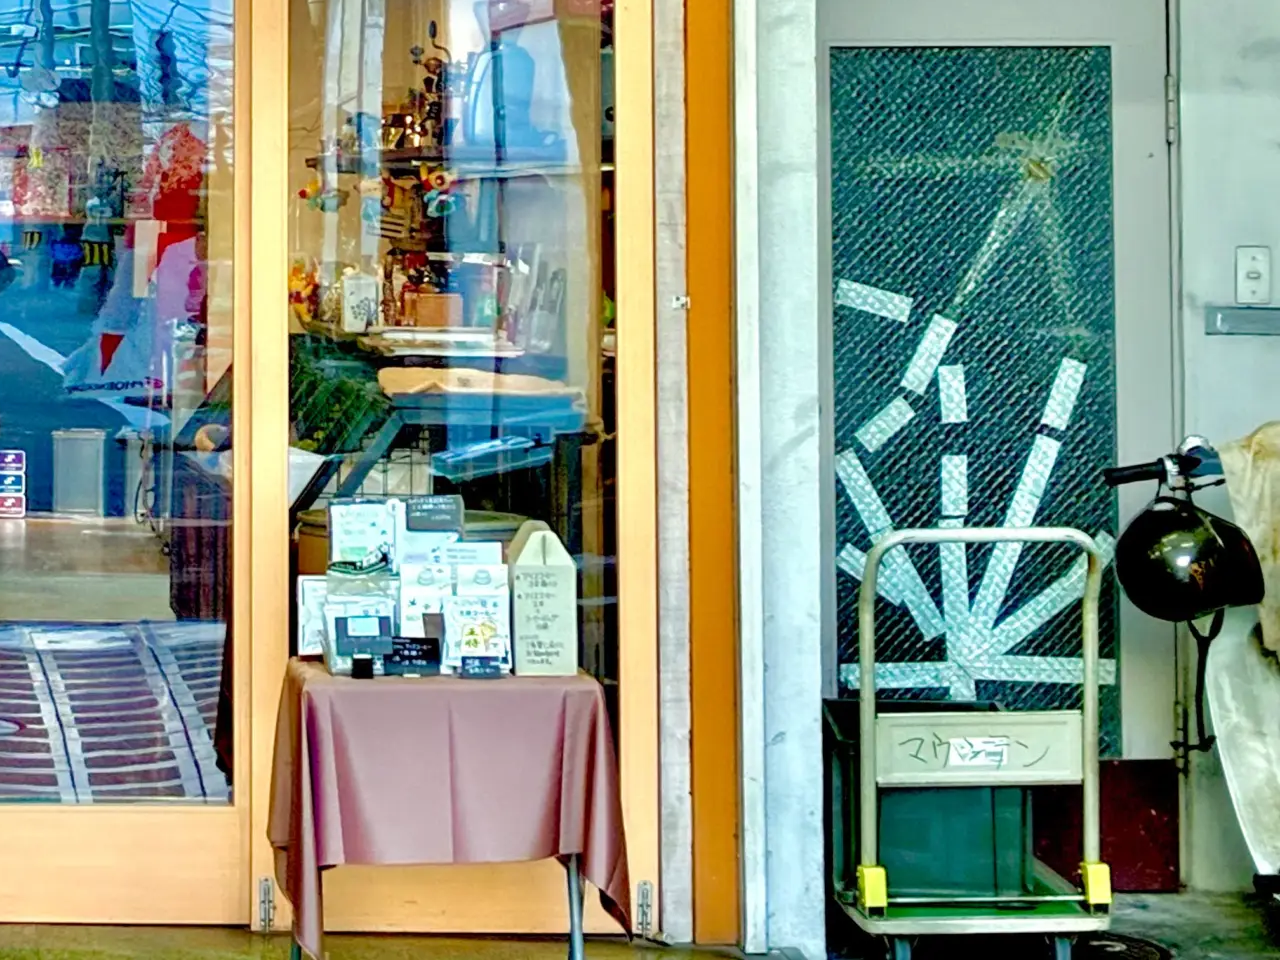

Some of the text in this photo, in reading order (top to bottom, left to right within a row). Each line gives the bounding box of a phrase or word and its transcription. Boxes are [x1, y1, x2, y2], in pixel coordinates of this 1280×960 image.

[898, 731, 1050, 770] マウンテン
